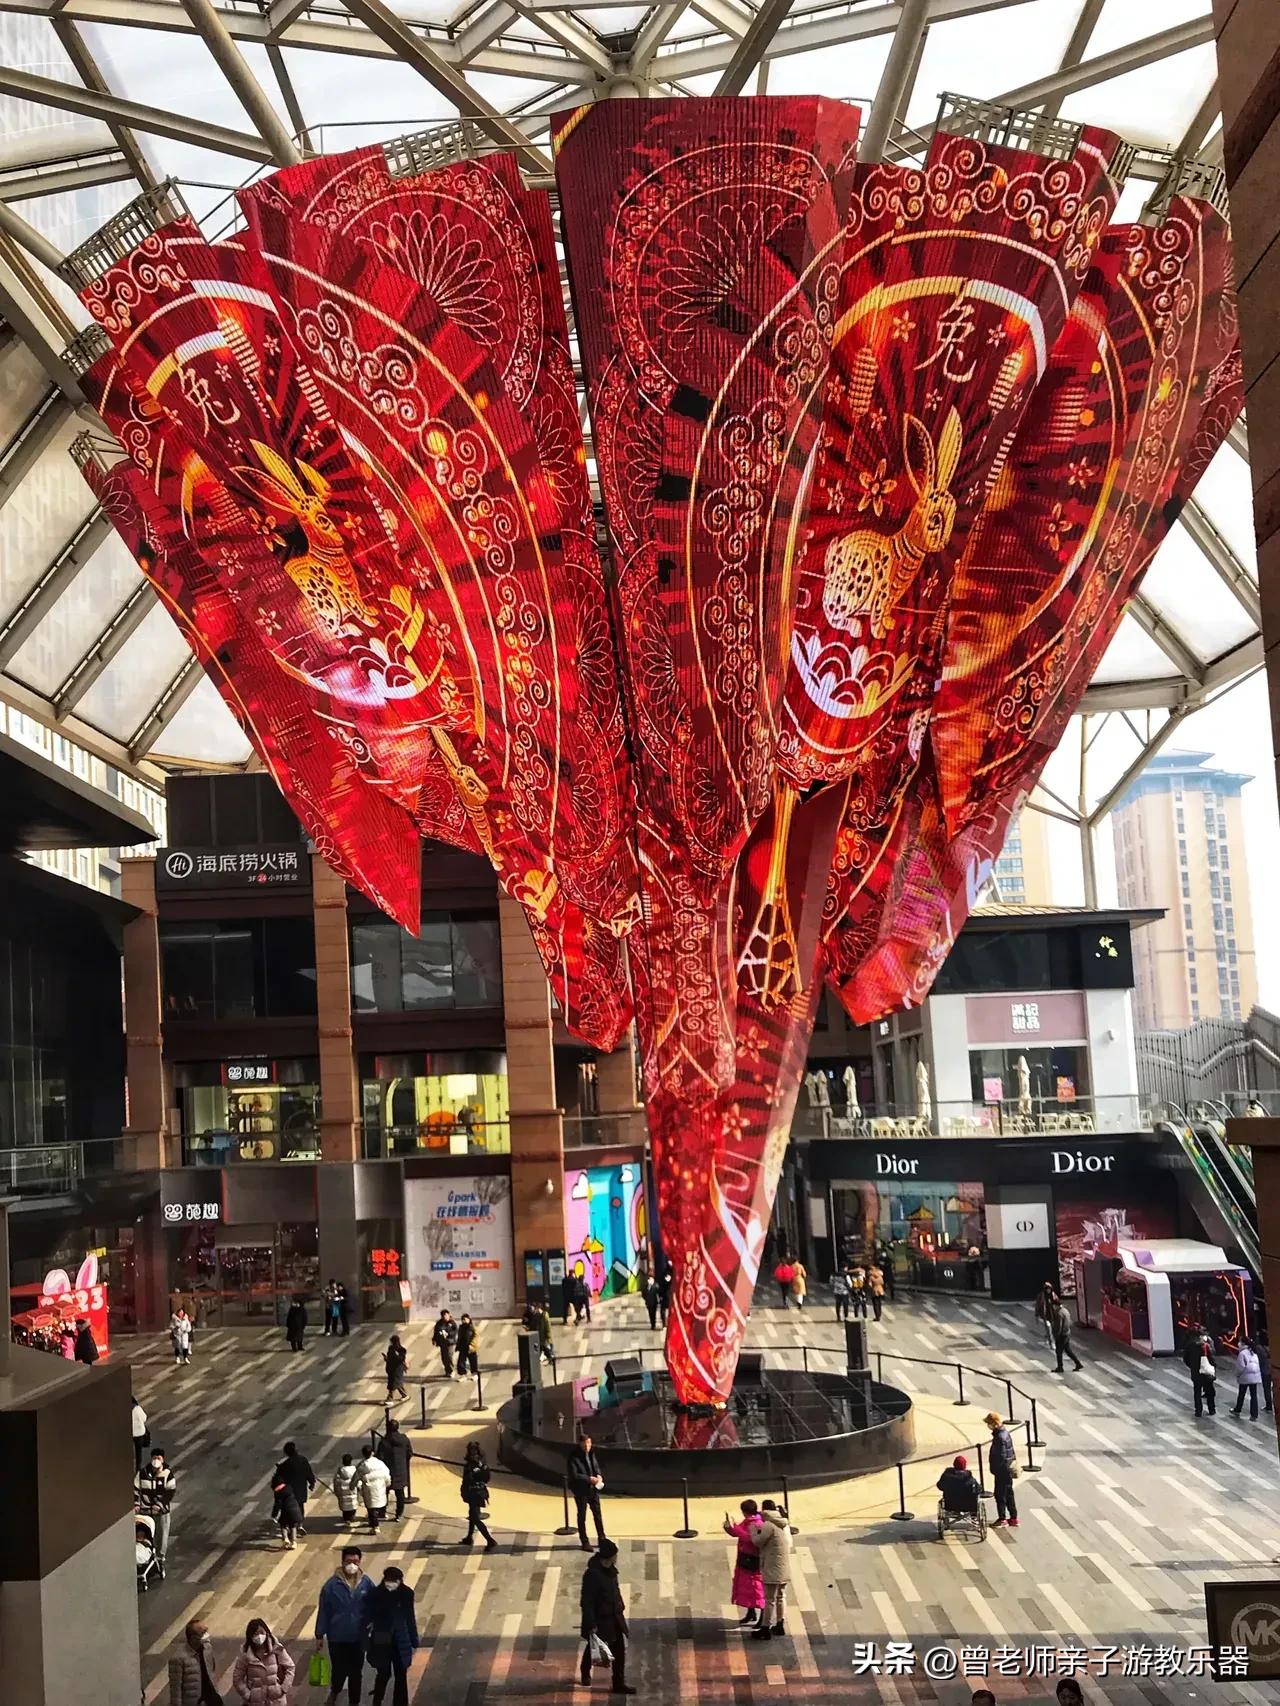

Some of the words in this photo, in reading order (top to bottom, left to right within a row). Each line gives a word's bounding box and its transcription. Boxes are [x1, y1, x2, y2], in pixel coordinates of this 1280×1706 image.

[914, 284, 977, 383] 兔
[177, 363, 241, 438] 兔
[197, 852, 298, 873] 海底捞火锅
[876, 1153, 919, 1174] Dior
[1051, 1151, 1115, 1173] Dior
[1237, 1619, 1280, 1646] MK
